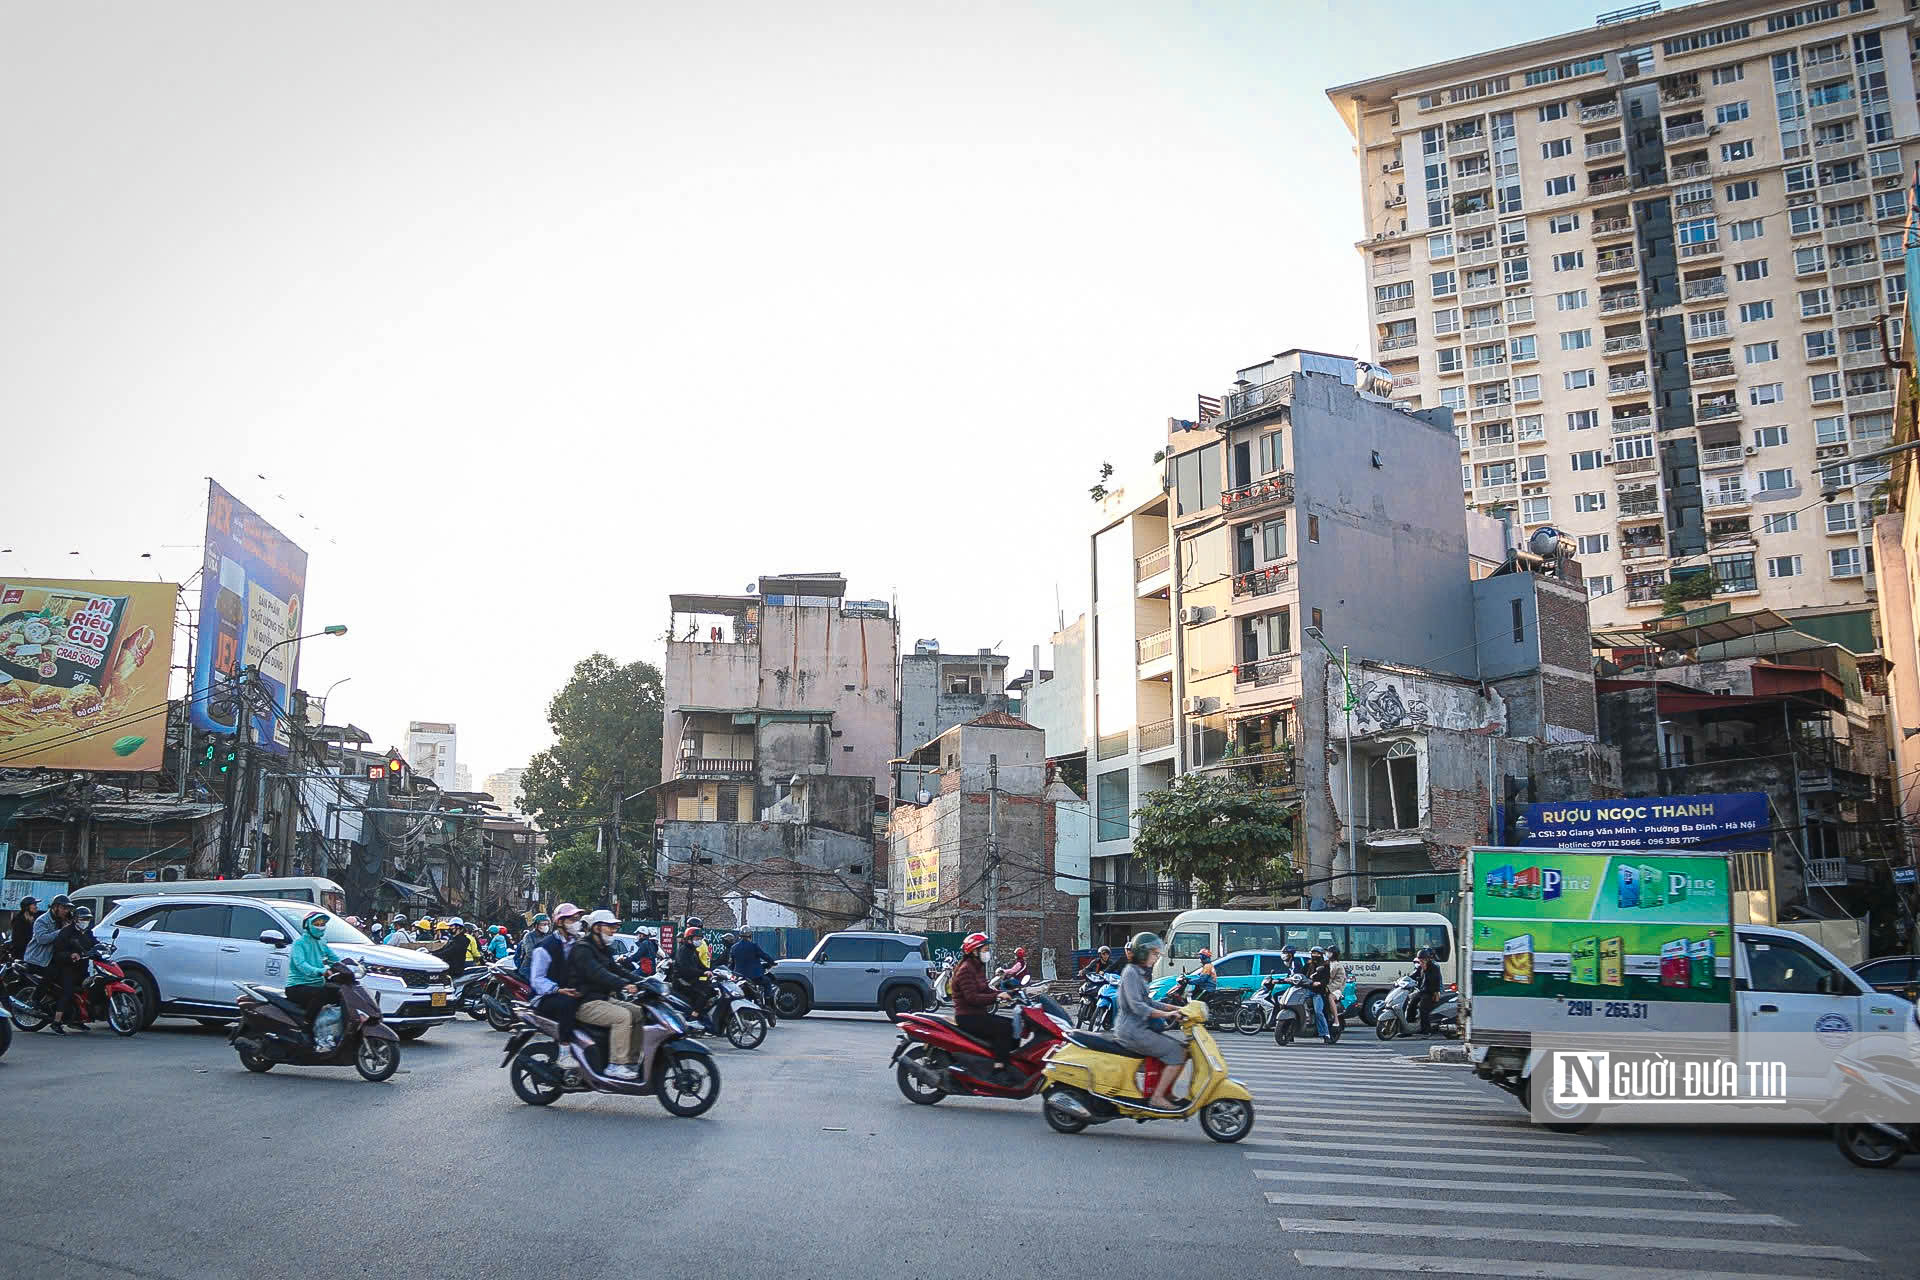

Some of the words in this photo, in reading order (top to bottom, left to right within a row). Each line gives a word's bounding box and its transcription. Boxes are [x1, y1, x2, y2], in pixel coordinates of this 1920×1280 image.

[88, 599, 113, 616] Mì
[73, 612, 111, 634] Riêu
[67, 625, 106, 650] Cua
[56, 647, 78, 660] CRAB
[78, 653, 100, 667] SOUP
[72, 673, 84, 682] 90
[370, 768, 383, 778] 27
[1542, 808, 1592, 825] RƯỢU
[1597, 807, 1648, 823] NGỌC
[1651, 803, 1715, 818] THANH
[1556, 829, 1568, 837] 30
[1569, 828, 1594, 838] Giang
[1596, 827, 1614, 835] Văn
[1615, 826, 1637, 835] Minh
[1644, 823, 1680, 833] Phường
[1681, 824, 1693, 832] Ba
[1695, 822, 1718, 831] Đình
[1725, 821, 1738, 830] Hà
[1740, 820, 1756, 830] Nội
[1558, 841, 1590, 849] Hotline:
[1591, 840, 1606, 848] 097
[1608, 839, 1619, 847] 112
[1620, 838, 1641, 846] 5066
[1648, 837, 1664, 845] 096
[1567, 1001, 1592, 1017] 29H
[1605, 1002, 1648, 1018] 265.31
